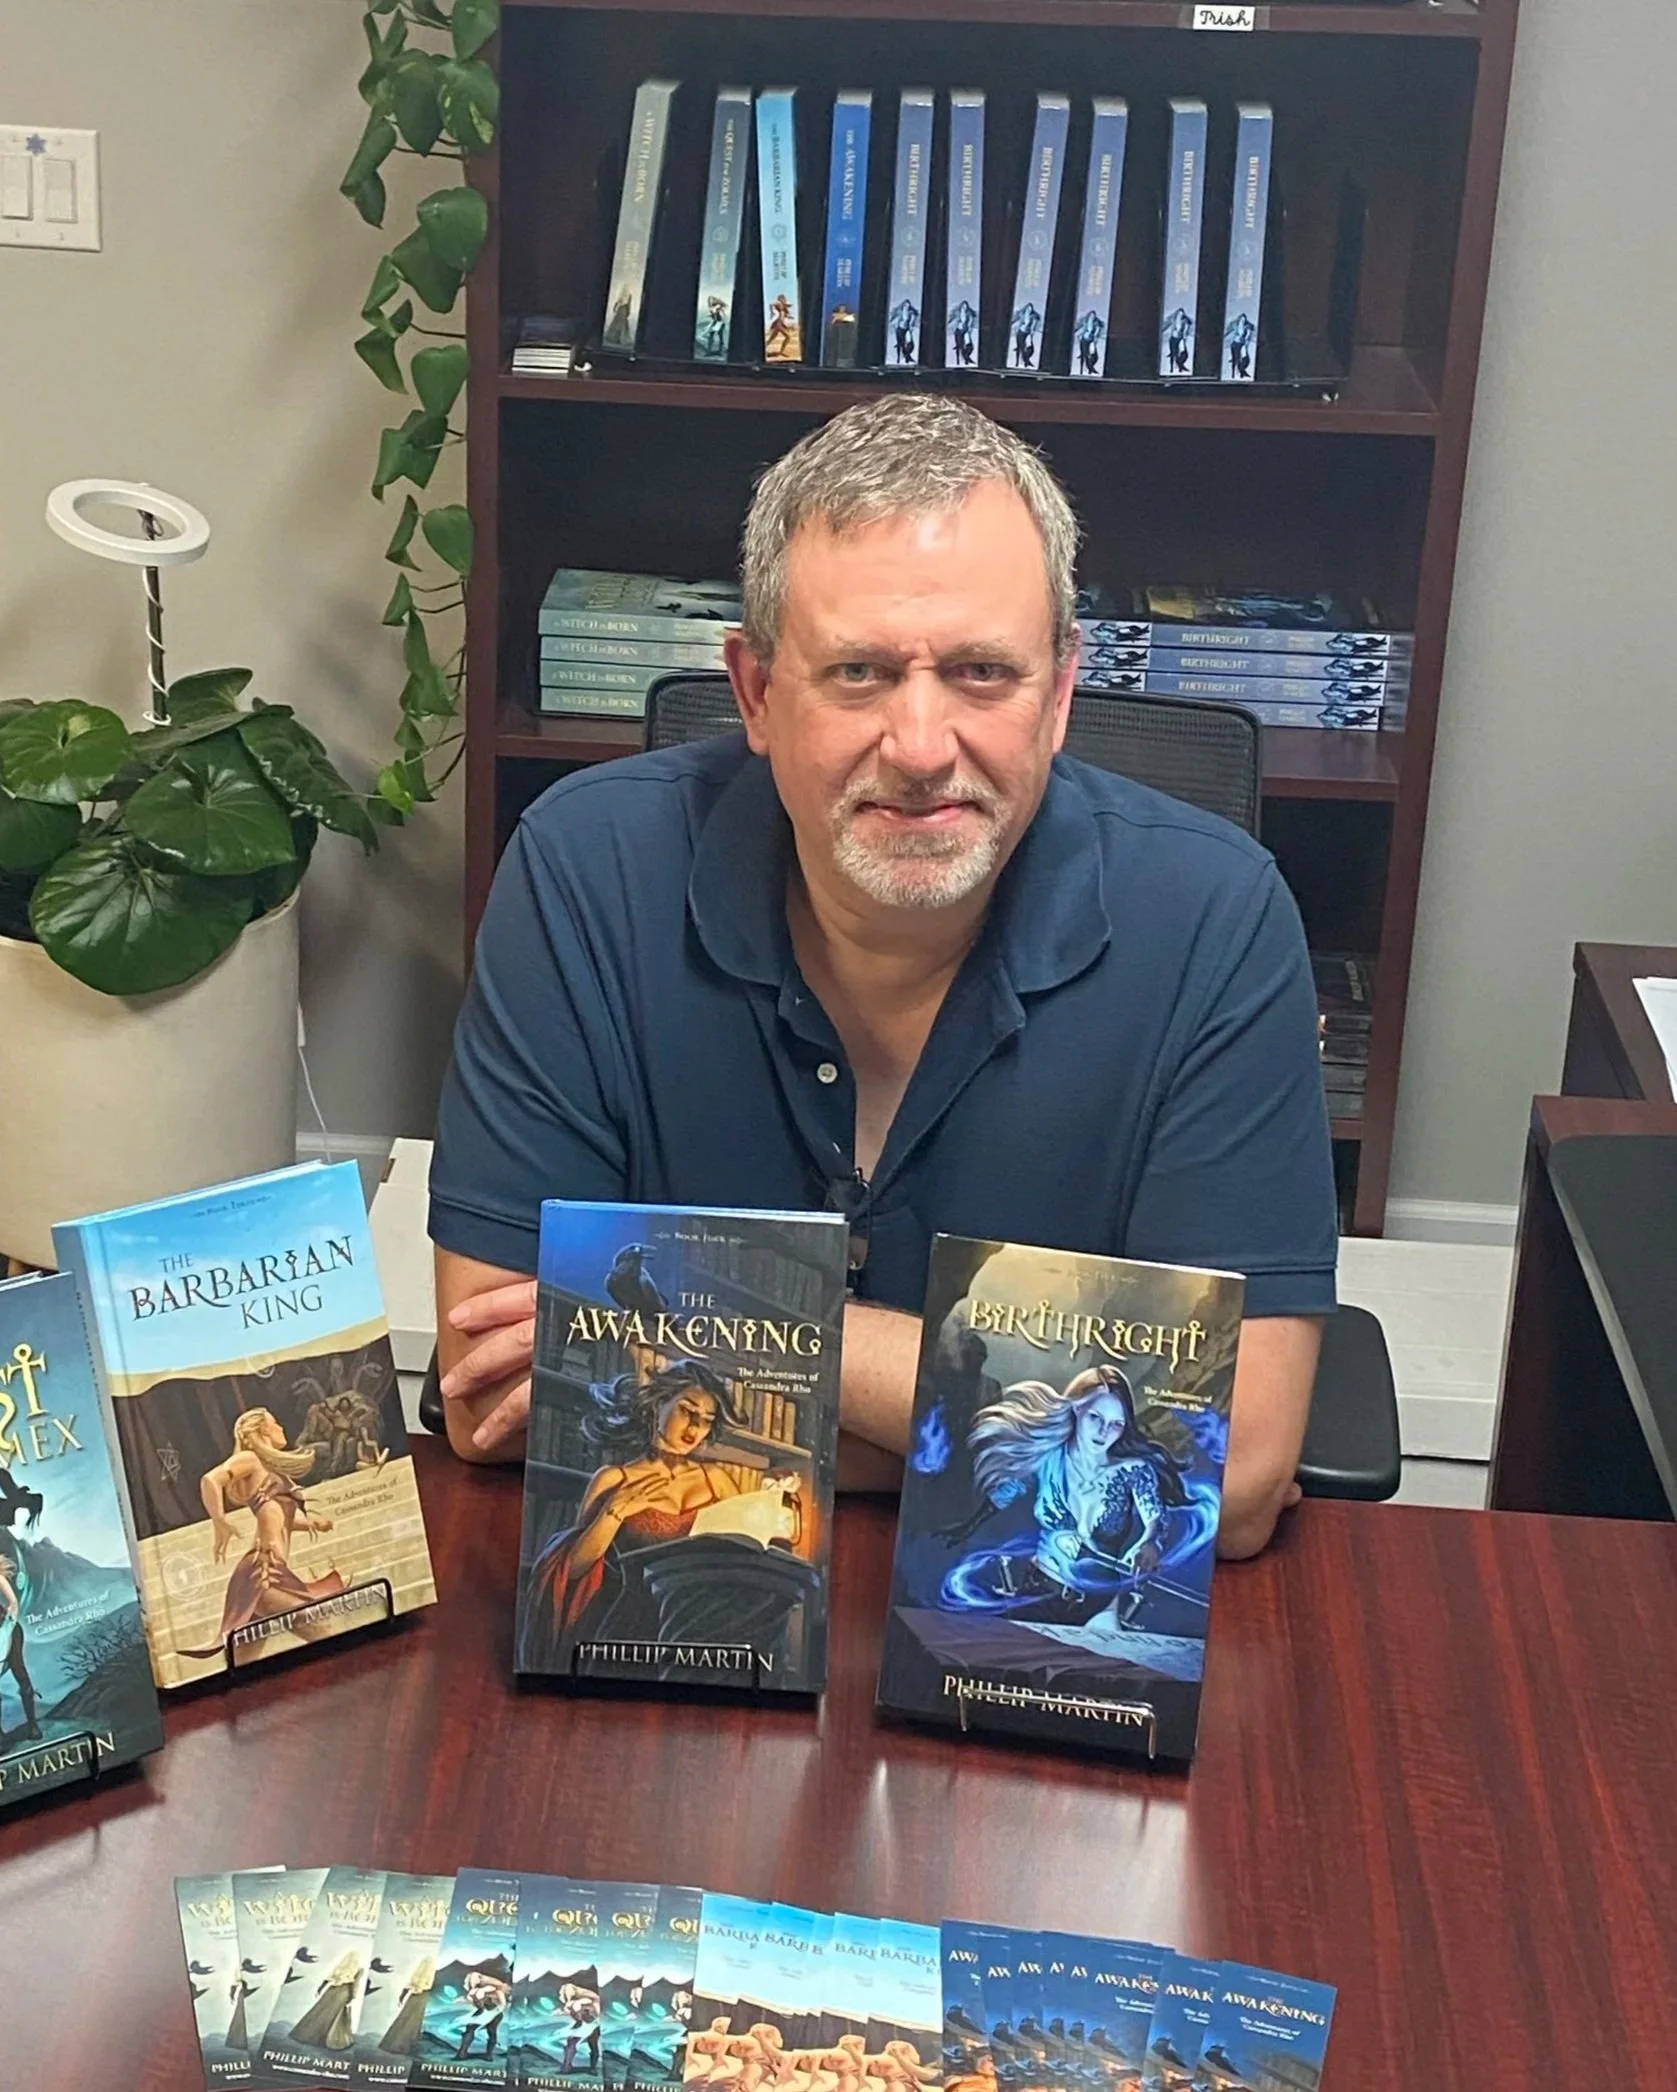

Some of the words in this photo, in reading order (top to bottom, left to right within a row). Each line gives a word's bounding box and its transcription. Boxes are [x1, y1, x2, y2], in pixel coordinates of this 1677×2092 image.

[1200, 9, 1251, 27] Trish
[842, 148, 856, 220] AWAKENING
[907, 143, 921, 216] BIRTHRIGHT
[962, 144, 974, 217] BIRTHRIGHT
[1036, 147, 1053, 220] BIRTHRIGHT
[1096, 154, 1114, 226] BIRTHRIGHT
[1179, 151, 1194, 224] BIRTHRIGHT
[1245, 156, 1259, 229] BIRTHRIGHT
[560, 617, 598, 629] WITCH
[607, 620, 638, 632] BORN
[1181, 632, 1249, 646] BIRTHRIGHT
[1180, 657, 1250, 669] BIRTHRIGHT
[1178, 680, 1246, 694] BIRTHRIGHT
[128, 1235, 354, 1321] BARBARIAN
[158, 1252, 194, 1273] THE
[240, 1284, 323, 1329] KING
[678, 1292, 716, 1309] THE
[566, 1305, 822, 1359] AWAKENING
[968, 1298, 1207, 1375] BIRTHRIGHT
[736, 1366, 754, 1377] The
[756, 1368, 807, 1381] Adventures
[808, 1371, 820, 1382] of
[743, 1380, 790, 1392] Cassandra
[26, 1612, 43, 1625] The
[45, 1598, 98, 1620] Adventures
[99, 1588, 112, 1602] of
[305, 1582, 388, 1625] MARTIN
[35, 1616, 84, 1635] Cassandra
[674, 1646, 773, 1673] MARTIN
[18, 1731, 116, 1785] MARTIN
[880, 1947, 937, 1967] BARBA
[1222, 1991, 1326, 2026] AWAKENING
[263, 2050, 310, 2065] PHILLIP
[313, 2057, 351, 2071] MART
[357, 2062, 405, 2075] PHILLIP
[421, 2062, 468, 2074] PHILLIP
